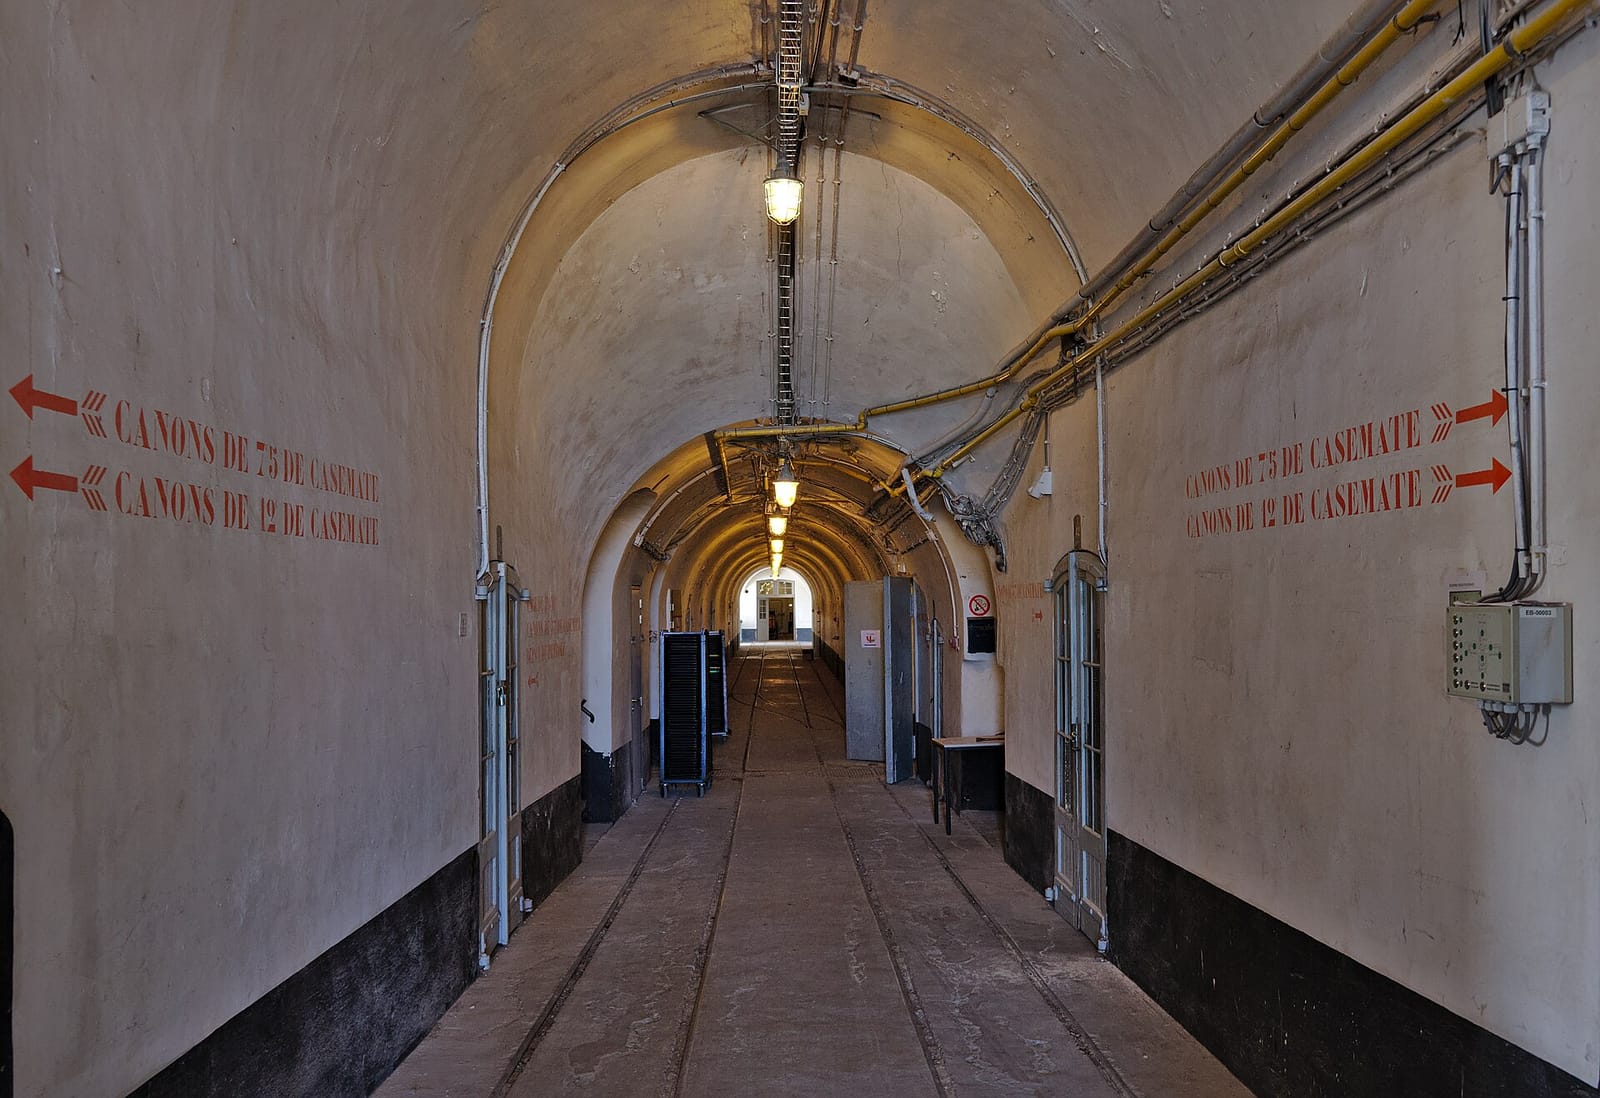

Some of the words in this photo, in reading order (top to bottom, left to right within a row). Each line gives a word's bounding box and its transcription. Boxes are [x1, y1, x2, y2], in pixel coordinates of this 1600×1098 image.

[114, 399, 215, 465] CANONS
[222, 430, 250, 474] DE
[255, 440, 279, 480] 75
[282, 448, 305, 486] DE
[310, 457, 379, 502] CASEMATE
[1185, 463, 1231, 499] CANONS
[1234, 457, 1254, 488] DE
[1257, 448, 1279, 485] 75
[1280, 441, 1305, 479] DE
[1309, 409, 1421, 469] CASEMATE
[114, 471, 215, 526] CANONS
[223, 488, 250, 530] DE
[259, 496, 278, 535] 12
[282, 502, 305, 539] DE
[310, 507, 379, 545] CASEMATE
[1186, 507, 1232, 538] CANONS
[1235, 502, 1255, 531] DE
[1260, 496, 1278, 530] 12
[1281, 491, 1306, 528] DE
[1310, 468, 1422, 521] CASEMATE
